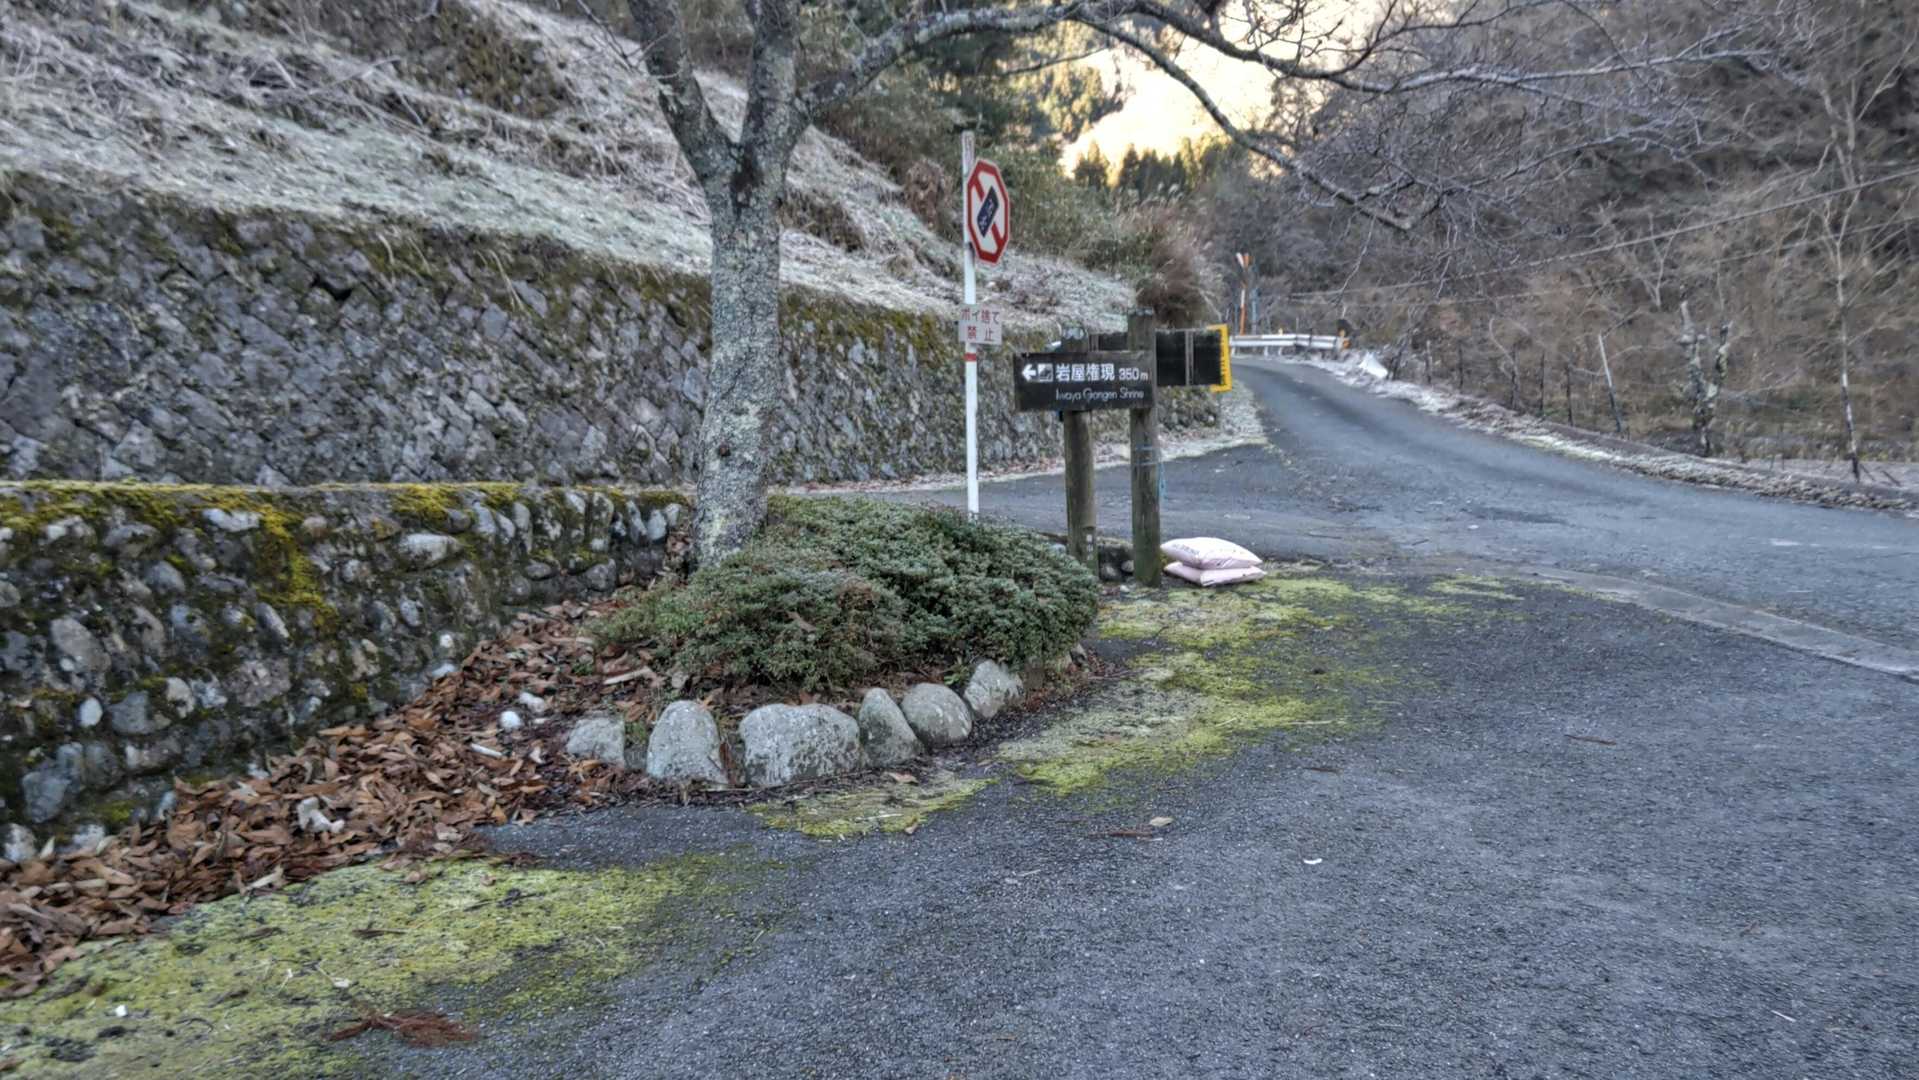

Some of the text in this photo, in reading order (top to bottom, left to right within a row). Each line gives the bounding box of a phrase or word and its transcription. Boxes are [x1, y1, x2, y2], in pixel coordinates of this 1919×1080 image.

[1056, 363, 1115, 382] 岩屋権現
[1055, 387, 1081, 403] Iwaya
